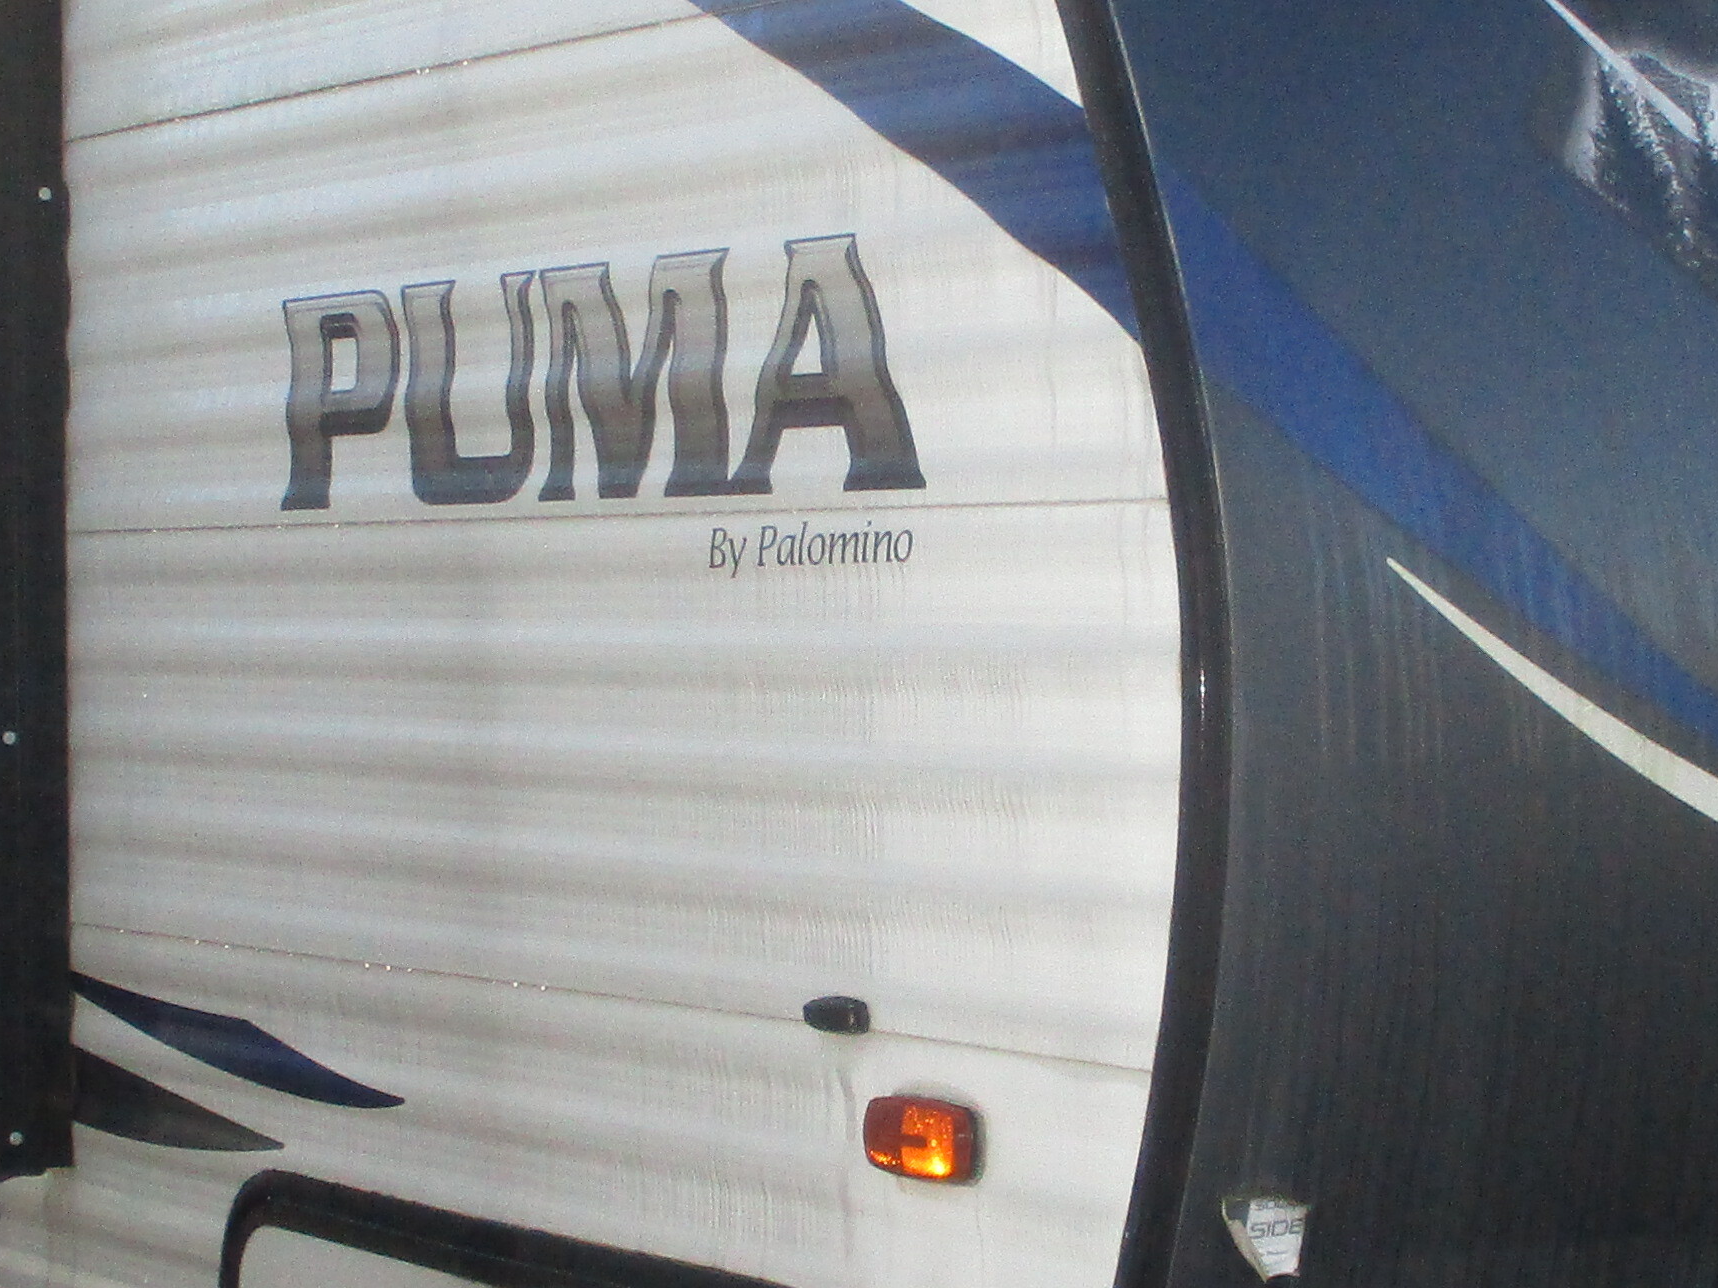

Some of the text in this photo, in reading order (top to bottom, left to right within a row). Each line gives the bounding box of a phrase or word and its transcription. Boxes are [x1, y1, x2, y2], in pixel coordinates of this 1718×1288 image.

[280, 232, 927, 512] PUMA
[708, 519, 914, 579] By Palomino
